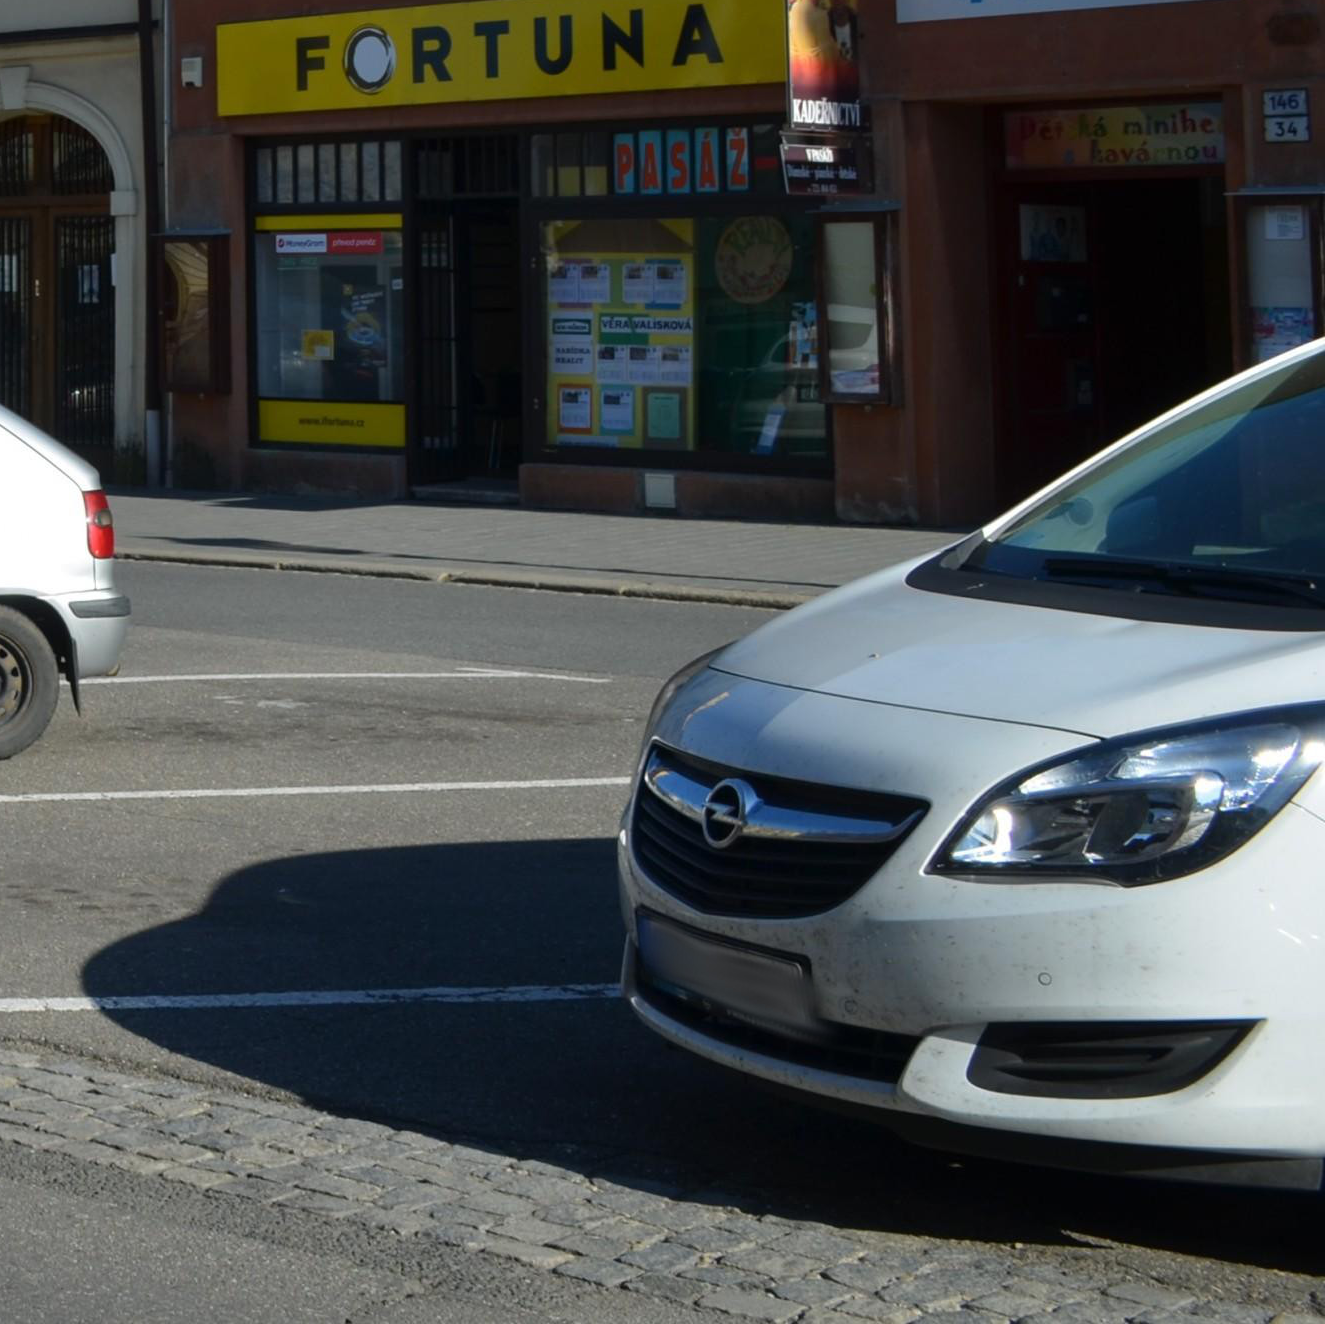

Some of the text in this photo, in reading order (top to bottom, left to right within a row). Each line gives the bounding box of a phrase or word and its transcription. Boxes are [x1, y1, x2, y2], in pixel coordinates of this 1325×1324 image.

[296, 3, 725, 95] FORTUNA
[793, 97, 860, 126] KADEŘNICTVÍ
[1269, 93, 1300, 111] 146
[1274, 121, 1298, 137] 34
[616, 127, 747, 190] PASÁŽ
[602, 316, 631, 330] VĚRA
